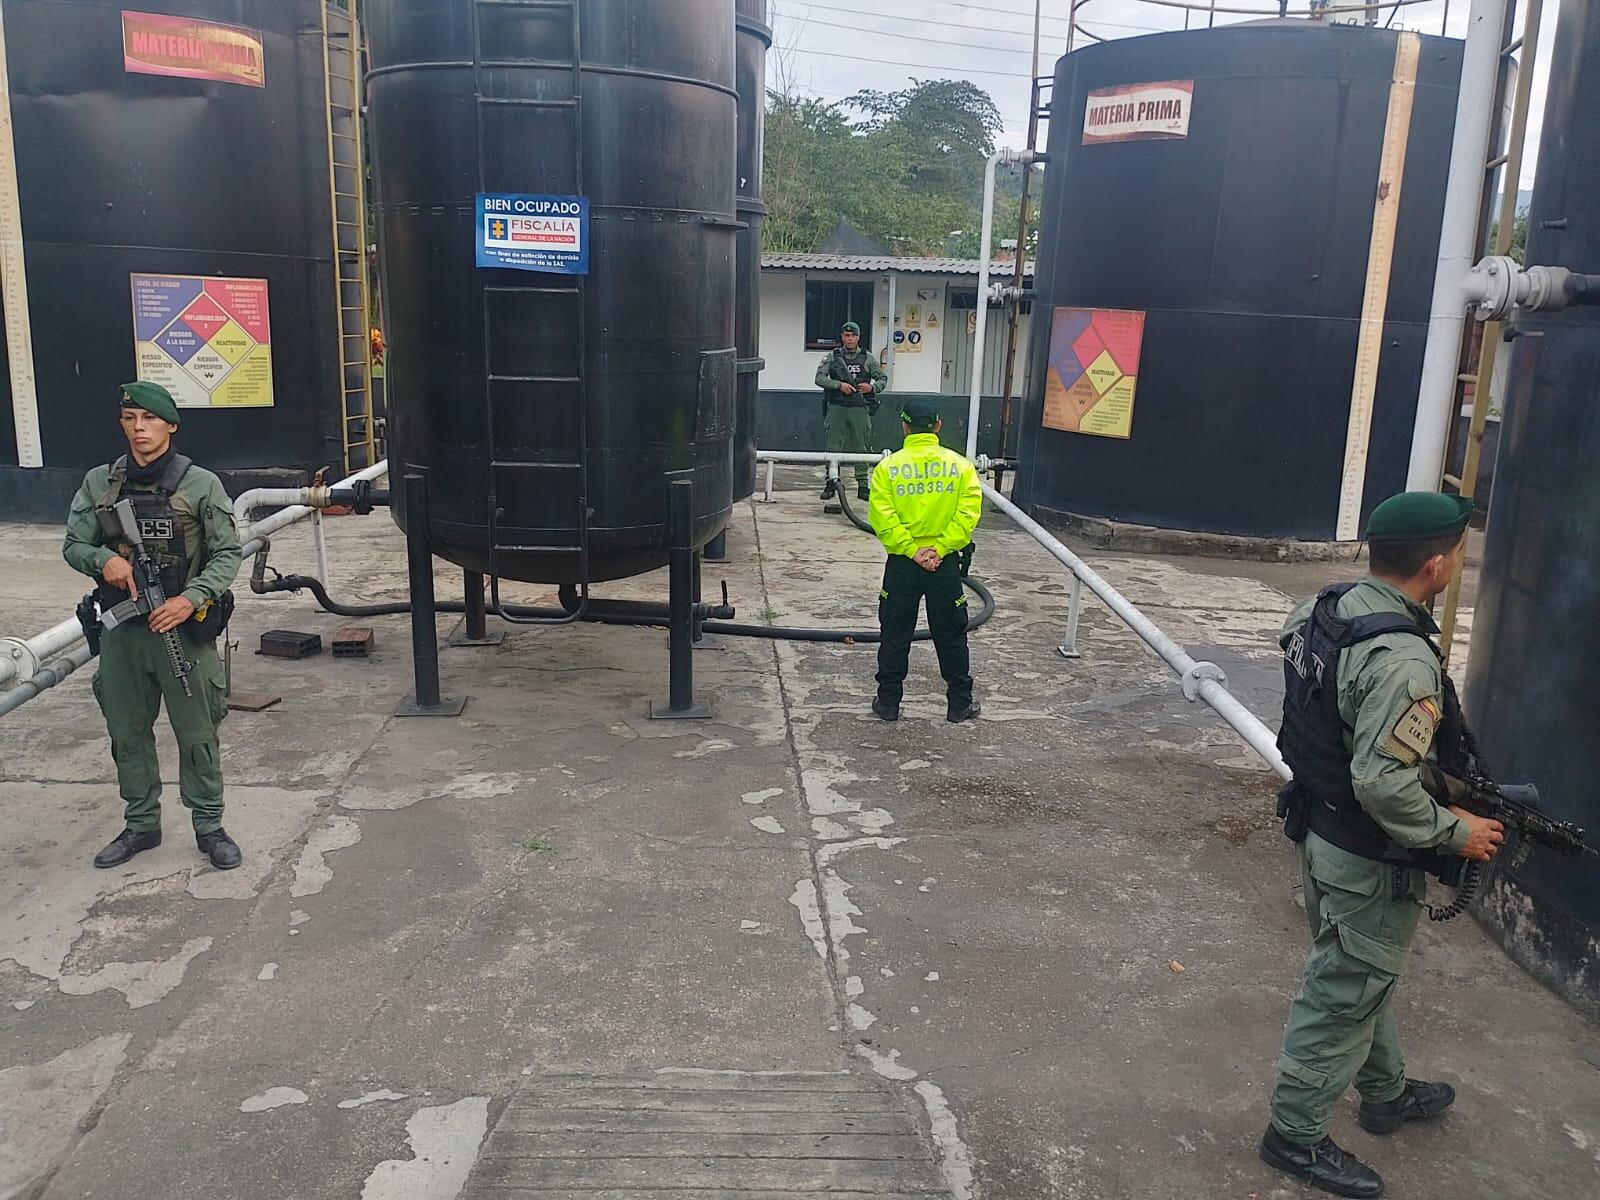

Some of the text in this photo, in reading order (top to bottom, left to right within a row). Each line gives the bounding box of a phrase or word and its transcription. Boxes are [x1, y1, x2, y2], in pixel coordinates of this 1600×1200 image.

[132, 31, 204, 59] MATERIA
[1089, 99, 1182, 127] MATERIA PRIMA
[485, 199, 580, 215] BIEN OCUPADO
[511, 218, 575, 232] FISCALÍA
[896, 481, 955, 496] 608384
